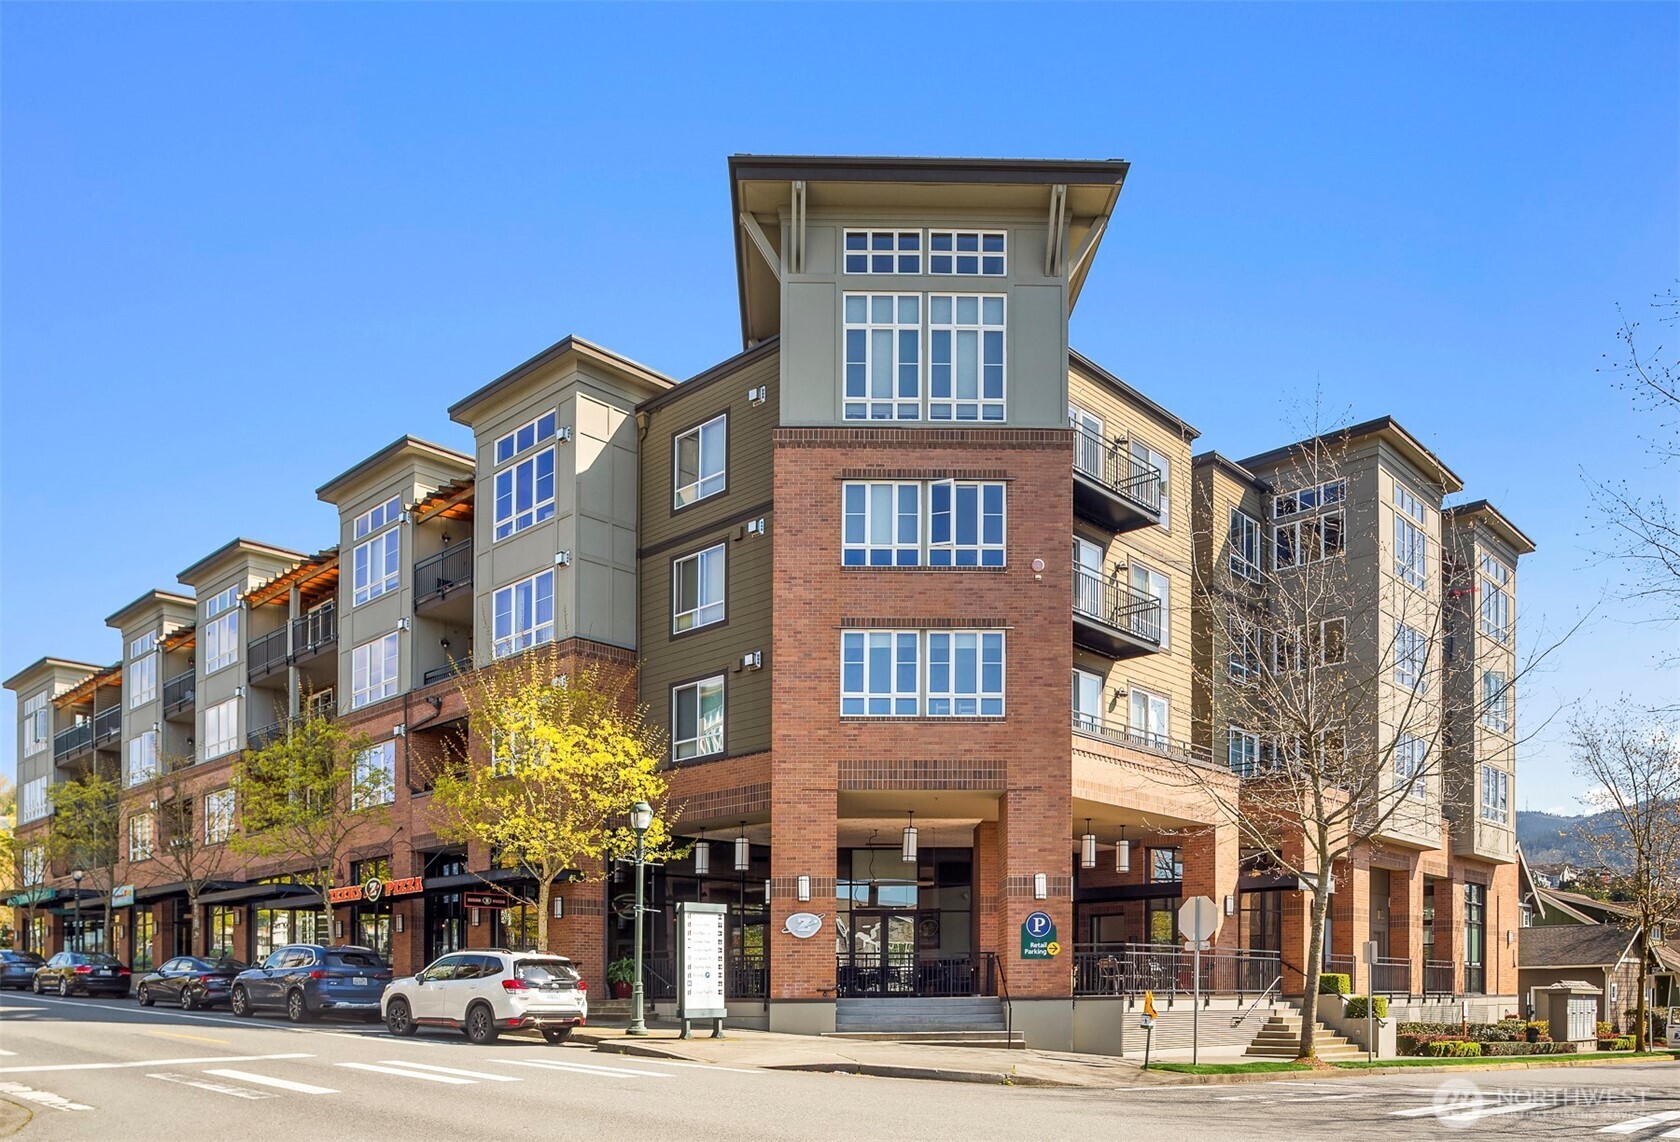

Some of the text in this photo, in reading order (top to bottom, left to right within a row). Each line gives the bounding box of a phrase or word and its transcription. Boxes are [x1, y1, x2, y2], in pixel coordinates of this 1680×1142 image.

[385, 876, 423, 896] PIZZA
[1032, 917, 1046, 933] P
[1024, 948, 1048, 956] Parking
